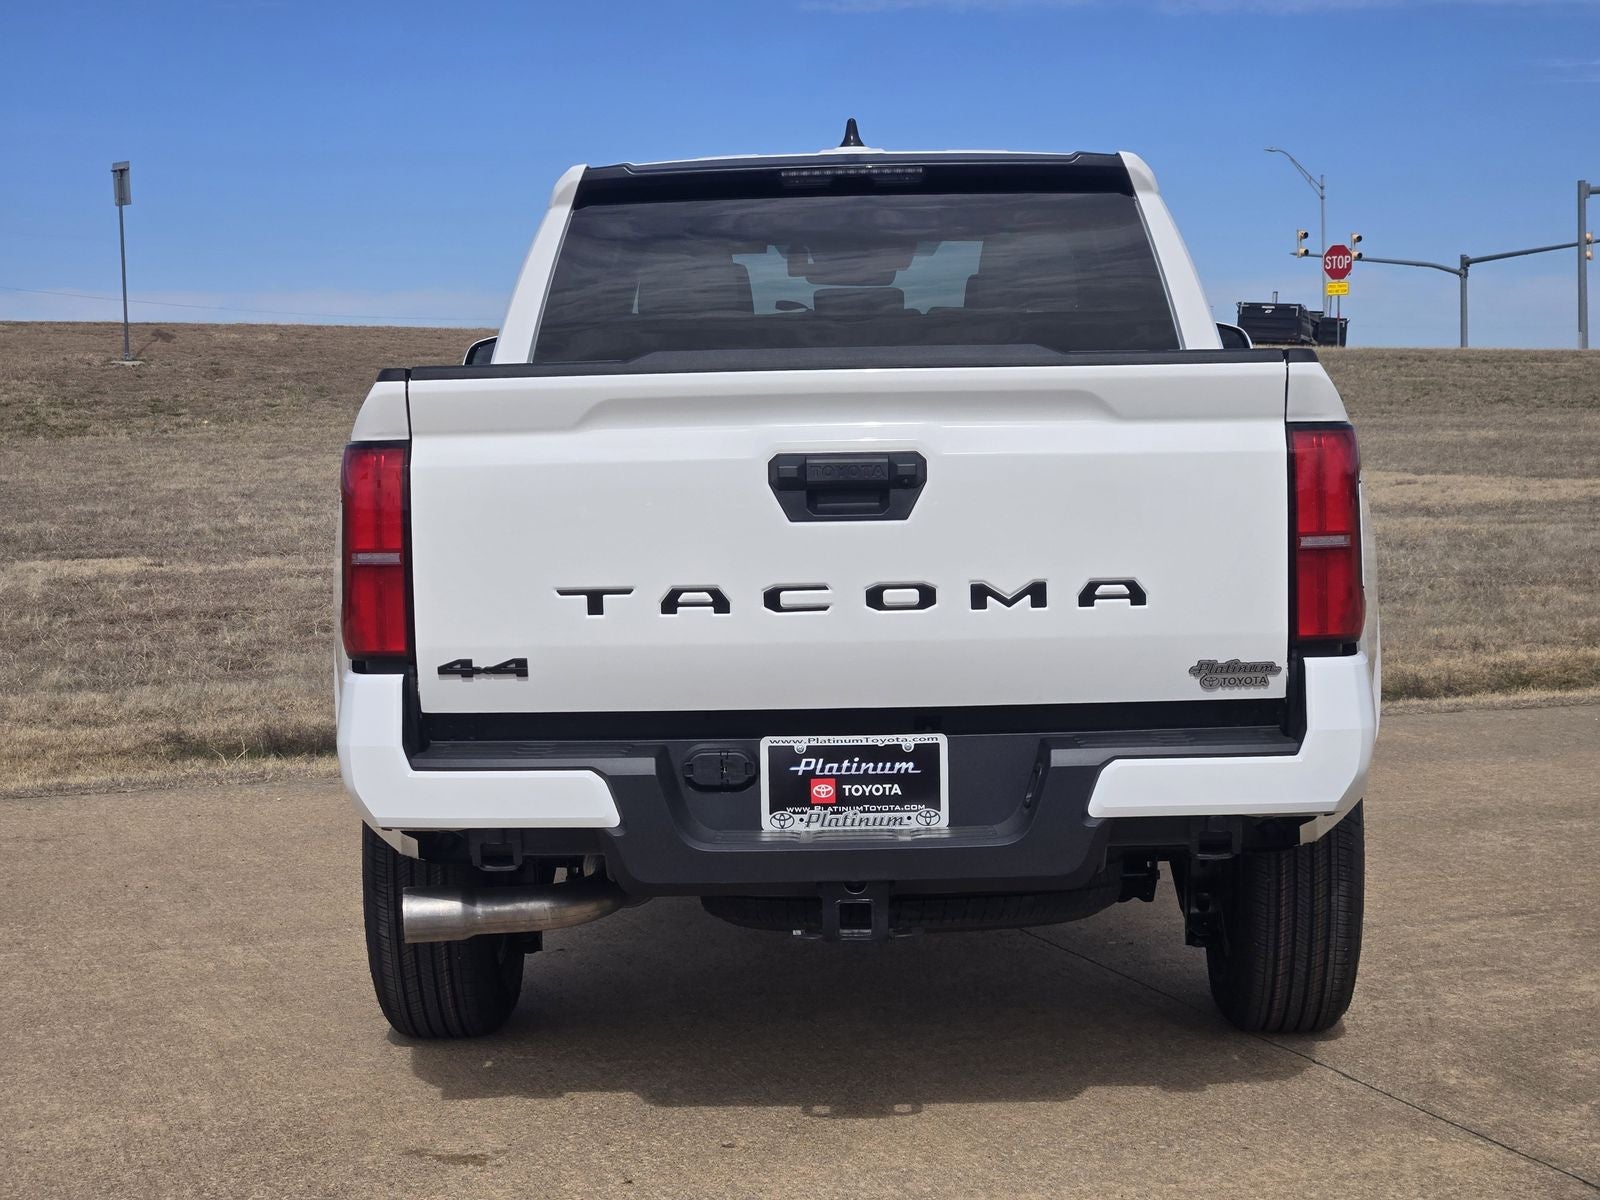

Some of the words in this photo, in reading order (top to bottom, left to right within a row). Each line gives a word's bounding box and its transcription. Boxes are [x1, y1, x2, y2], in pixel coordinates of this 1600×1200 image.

[1325, 255, 1351, 270] STOP
[809, 464, 886, 479] TOYOTA
[554, 577, 1148, 616] TACOMA
[1189, 659, 1282, 676] Platinum
[1221, 676, 1268, 686] TOYOTA
[769, 735, 939, 745] www.PlatinumToyota.com
[789, 757, 922, 776] Platinum
[843, 784, 902, 797] TOYOTA
[805, 811, 910, 829] Platinum
